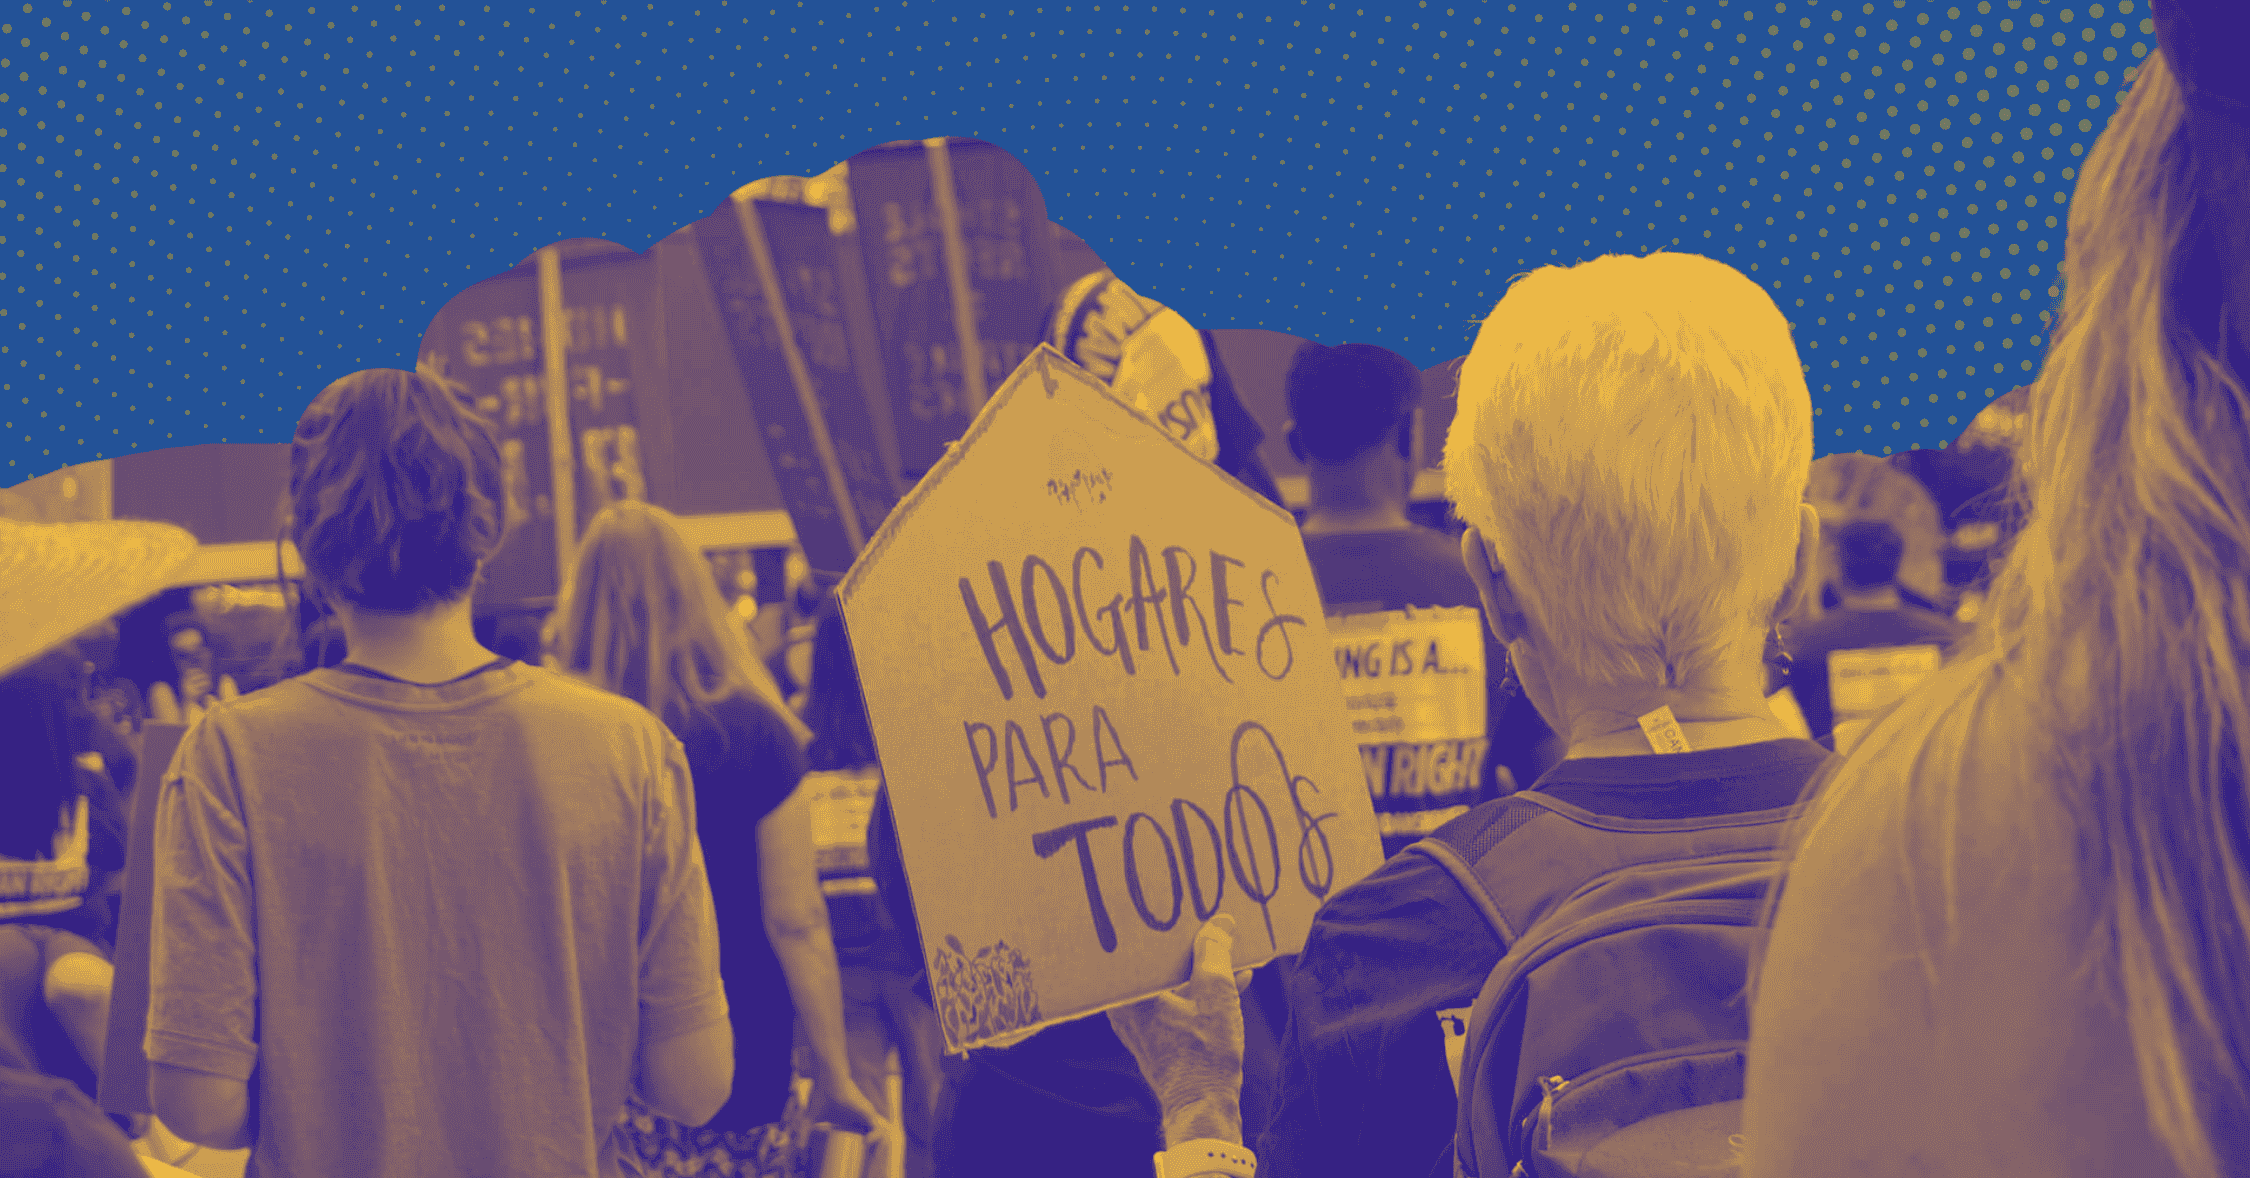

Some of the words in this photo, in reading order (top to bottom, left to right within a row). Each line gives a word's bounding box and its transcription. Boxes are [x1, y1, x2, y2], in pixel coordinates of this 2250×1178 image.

[957, 534, 1306, 701] HOGARES
[1389, 640, 1414, 677] IS
[963, 704, 1139, 819] PARA
[1388, 738, 1490, 797] RIGHT
